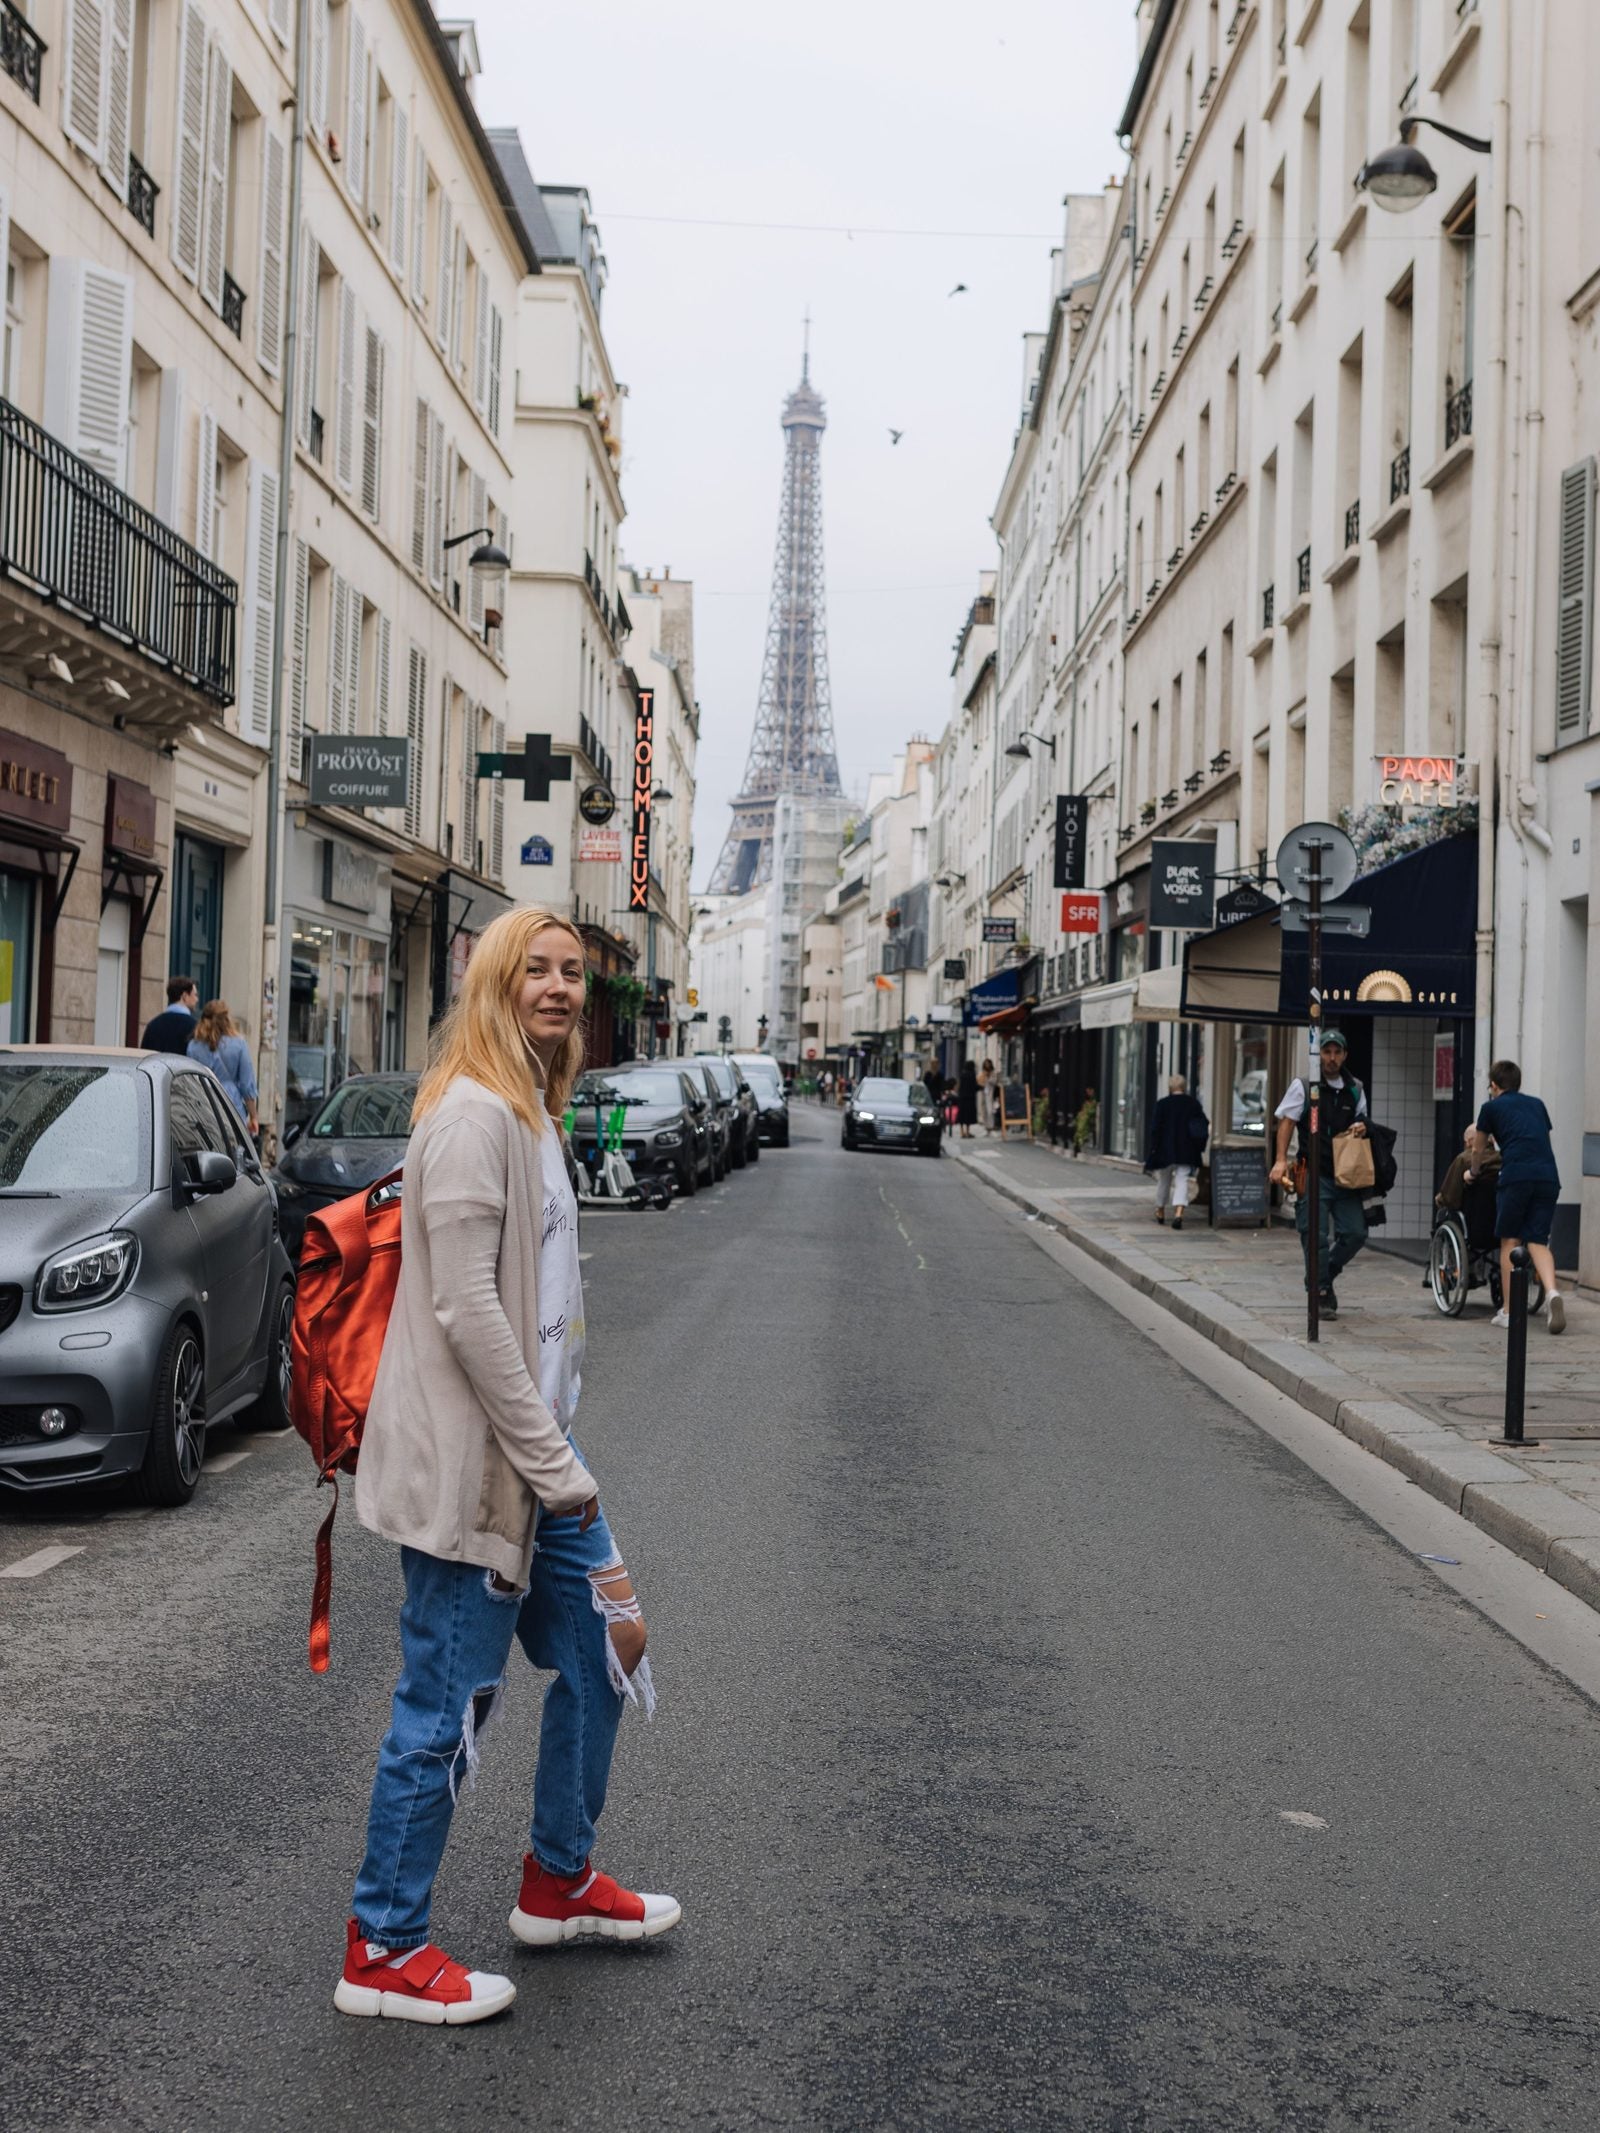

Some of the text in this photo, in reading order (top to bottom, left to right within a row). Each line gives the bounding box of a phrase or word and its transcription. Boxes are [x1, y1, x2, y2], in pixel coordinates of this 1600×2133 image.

[343, 746, 379, 756] FRANCK
[317, 752, 404, 773] PROVOST
[1383, 756, 1454, 782] PAON
[0, 759, 60, 805] RLET
[328, 783, 390, 797] COIFFURE
[631, 692, 654, 907] THOUMIEUX
[1380, 780, 1452, 808] CAFE
[581, 831, 621, 841] LAVERIE
[1064, 803, 1079, 881] HÔTEL
[1166, 865, 1200, 880] BLANC
[1162, 883, 1203, 896] VOSGES
[1068, 905, 1098, 921] SFR
[1322, 989, 1457, 1004] AON CAFE
